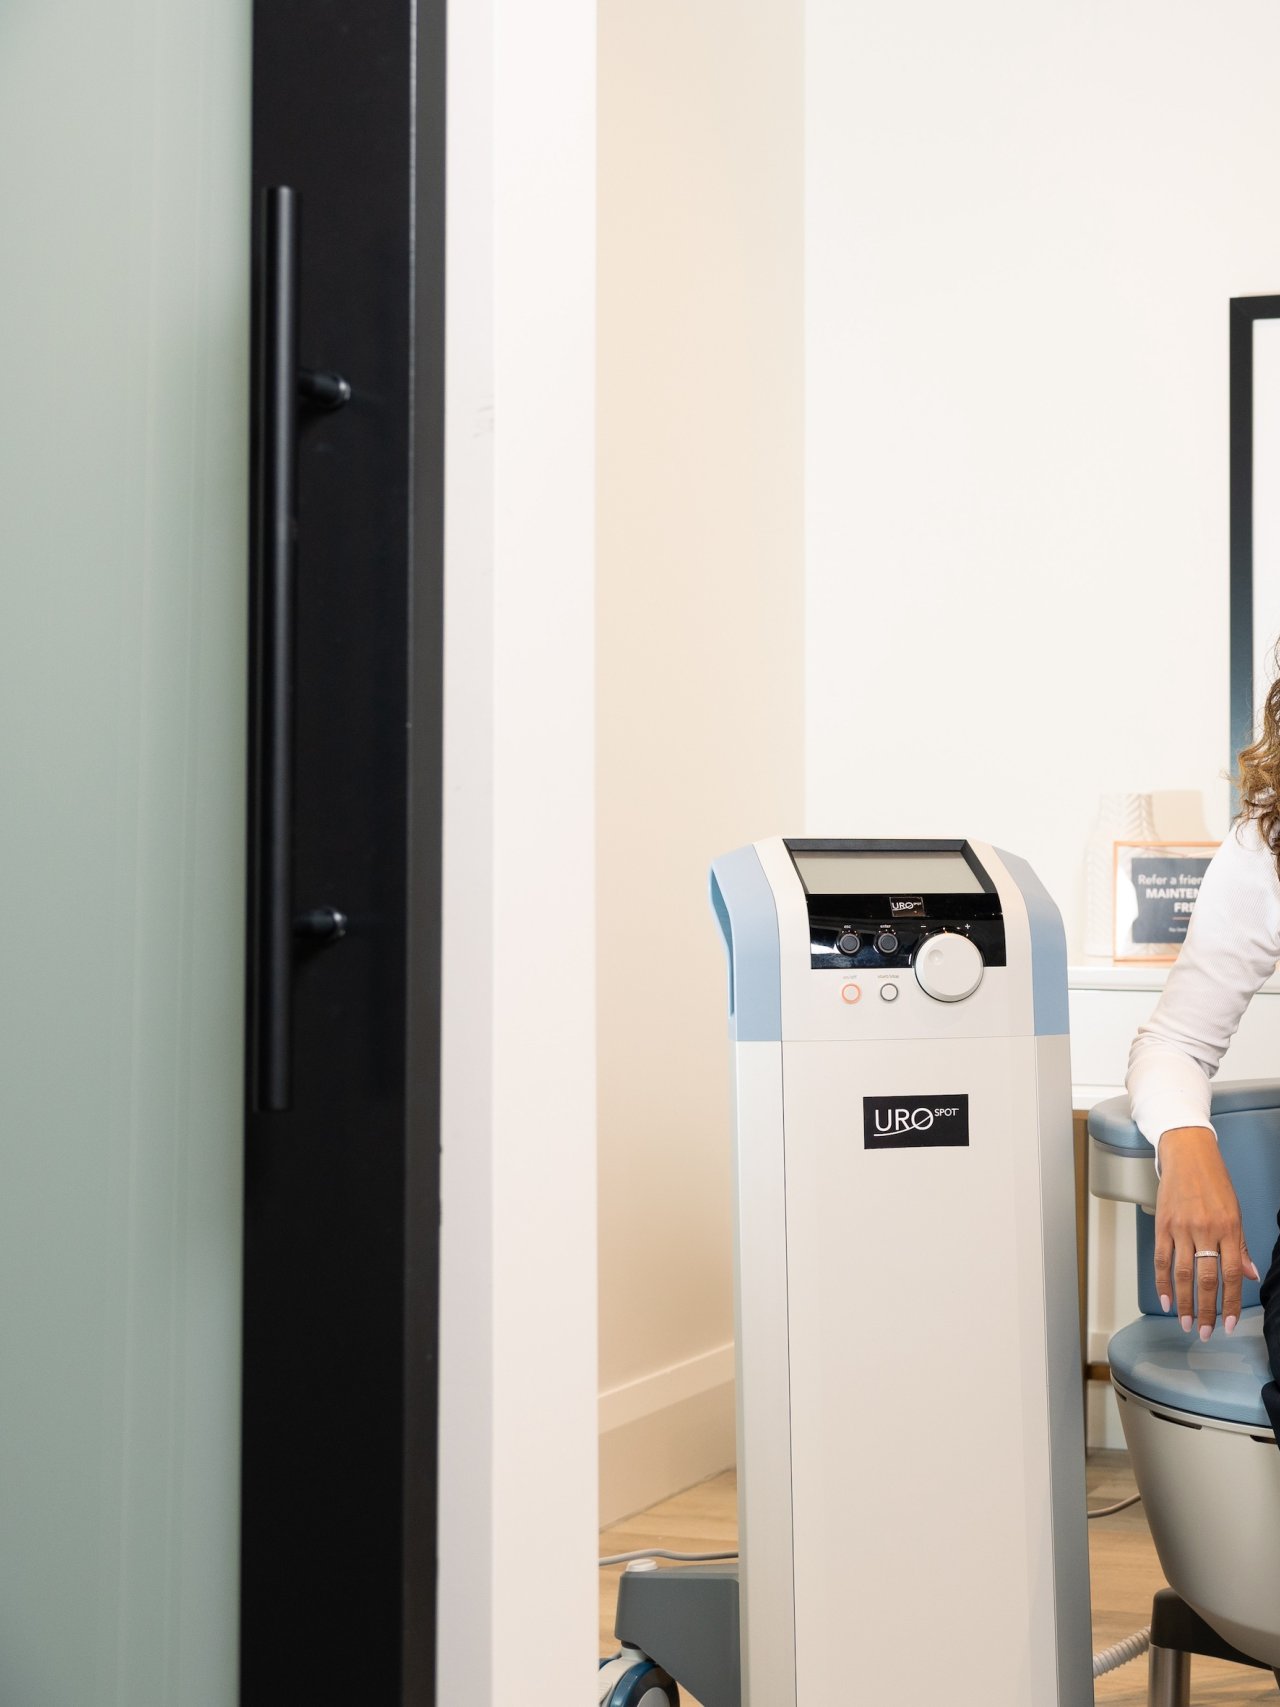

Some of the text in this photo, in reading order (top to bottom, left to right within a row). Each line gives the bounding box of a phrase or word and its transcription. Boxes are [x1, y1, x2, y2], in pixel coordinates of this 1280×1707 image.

[1138, 873, 1203, 886] Refer a frien
[874, 1107, 960, 1135] URO SPOT
